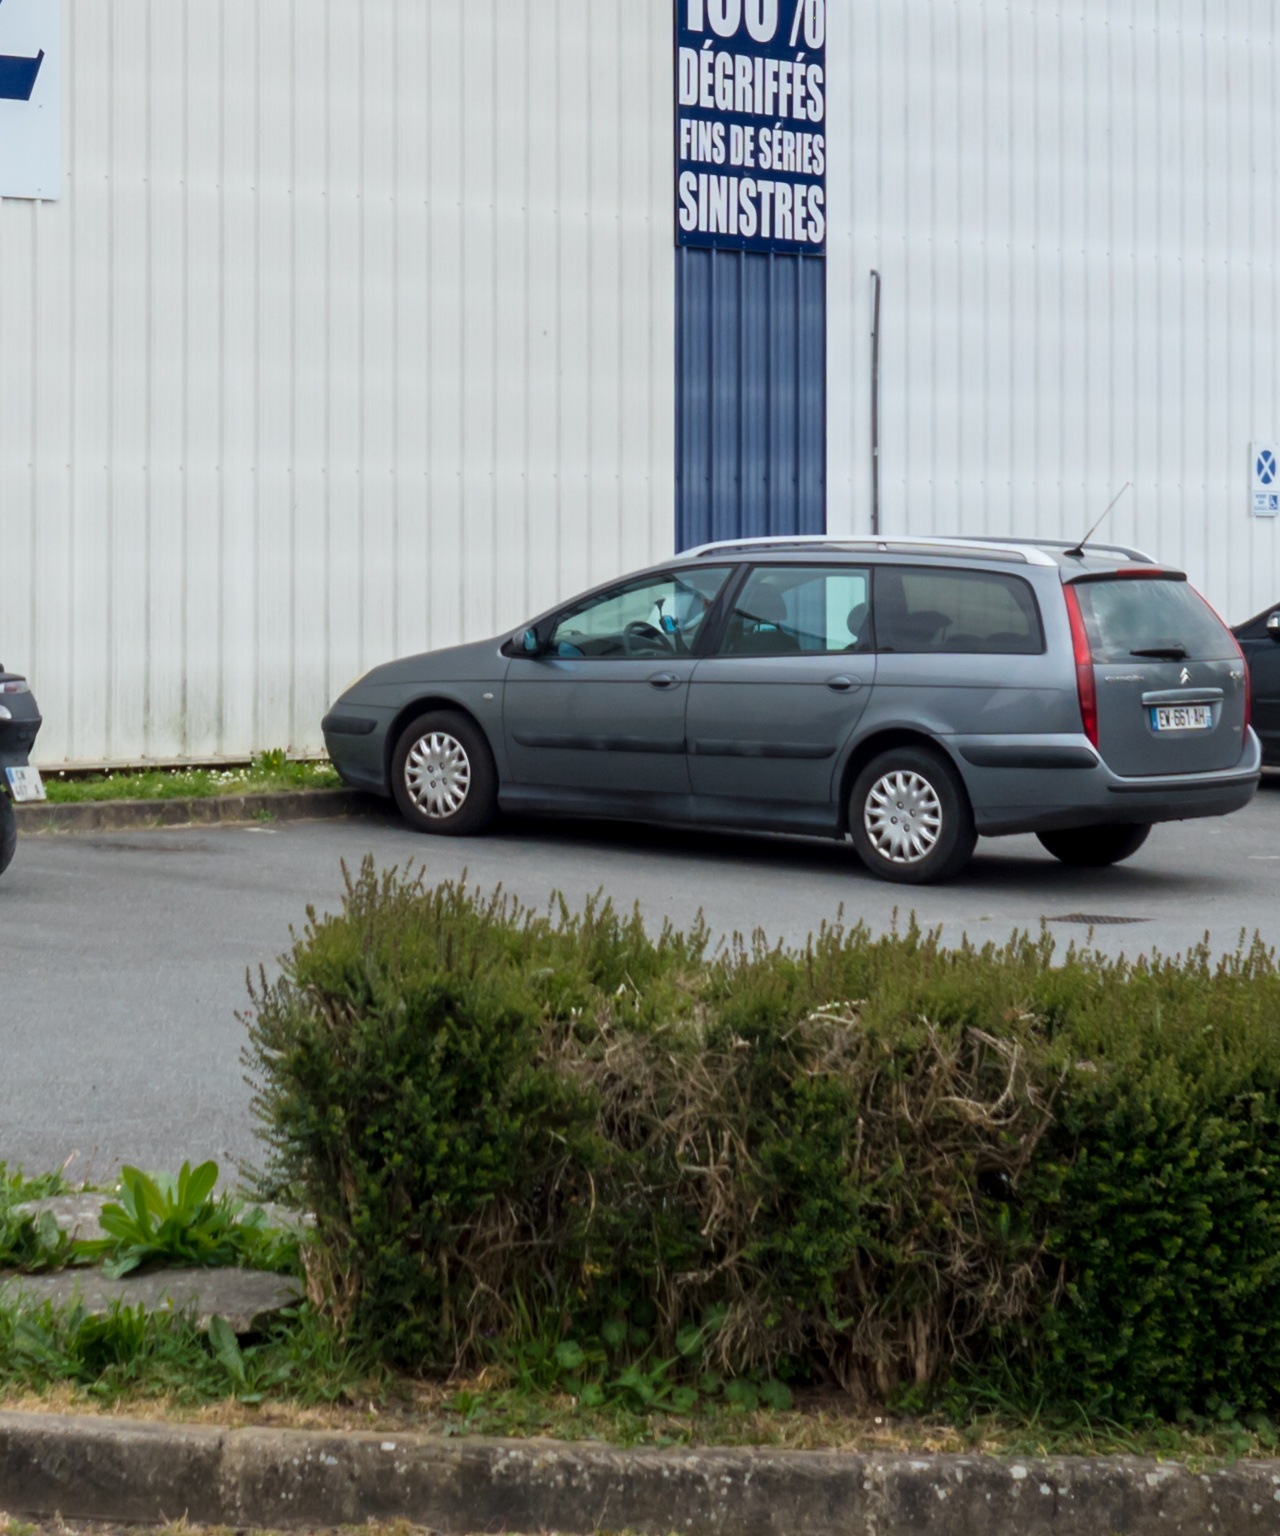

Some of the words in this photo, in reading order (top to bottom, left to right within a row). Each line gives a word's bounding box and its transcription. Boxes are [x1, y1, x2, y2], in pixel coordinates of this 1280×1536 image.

[678, 38, 824, 123] DÉGRIFFÉS
[680, 117, 726, 165] FINS
[729, 123, 755, 168] DE
[758, 121, 825, 176] SÉRIES
[678, 170, 826, 244] SINISTRES
